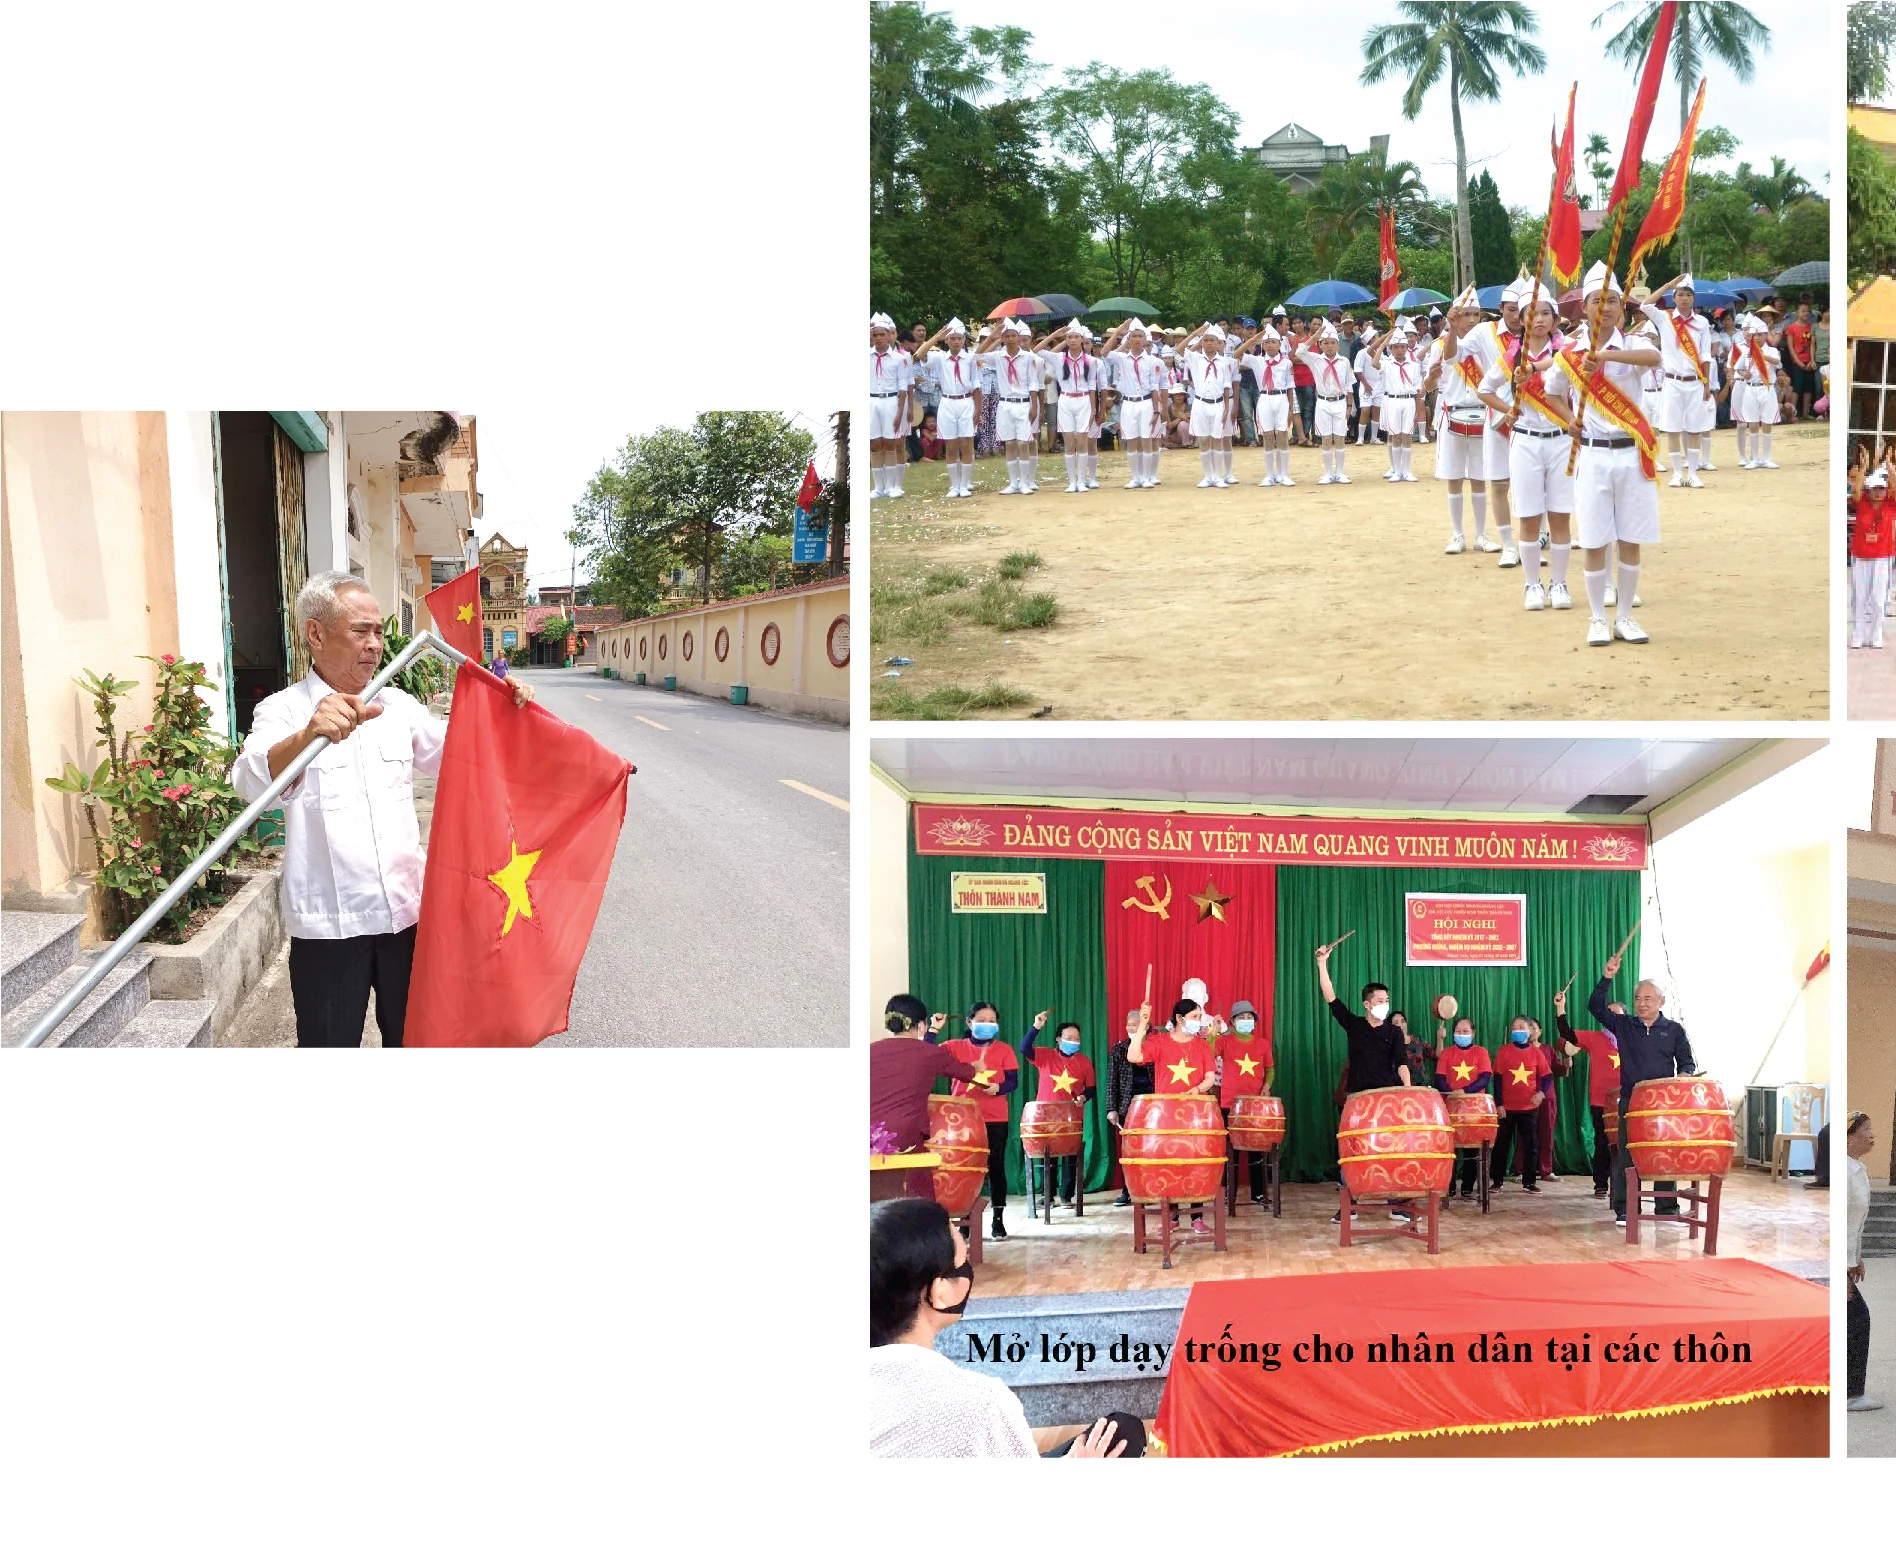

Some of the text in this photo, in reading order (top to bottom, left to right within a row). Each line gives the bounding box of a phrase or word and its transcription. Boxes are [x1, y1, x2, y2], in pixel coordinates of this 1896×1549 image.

[1003, 814, 1071, 848] ĐẢNG
[1077, 820, 1141, 854] CỘNG
[1147, 819, 1193, 852] SẢN
[1200, 825, 1252, 859] VIỆT
[1257, 833, 1308, 855] NAM
[1313, 833, 1390, 858] QUANG
[1395, 836, 1449, 857] VINH
[1455, 830, 1516, 859] MUÔN
[1521, 833, 1567, 859] NĂM
[958, 889, 1039, 906] THÔN THÀNH NAM
[1433, 916, 1497, 931] HỘI NGHỊ
